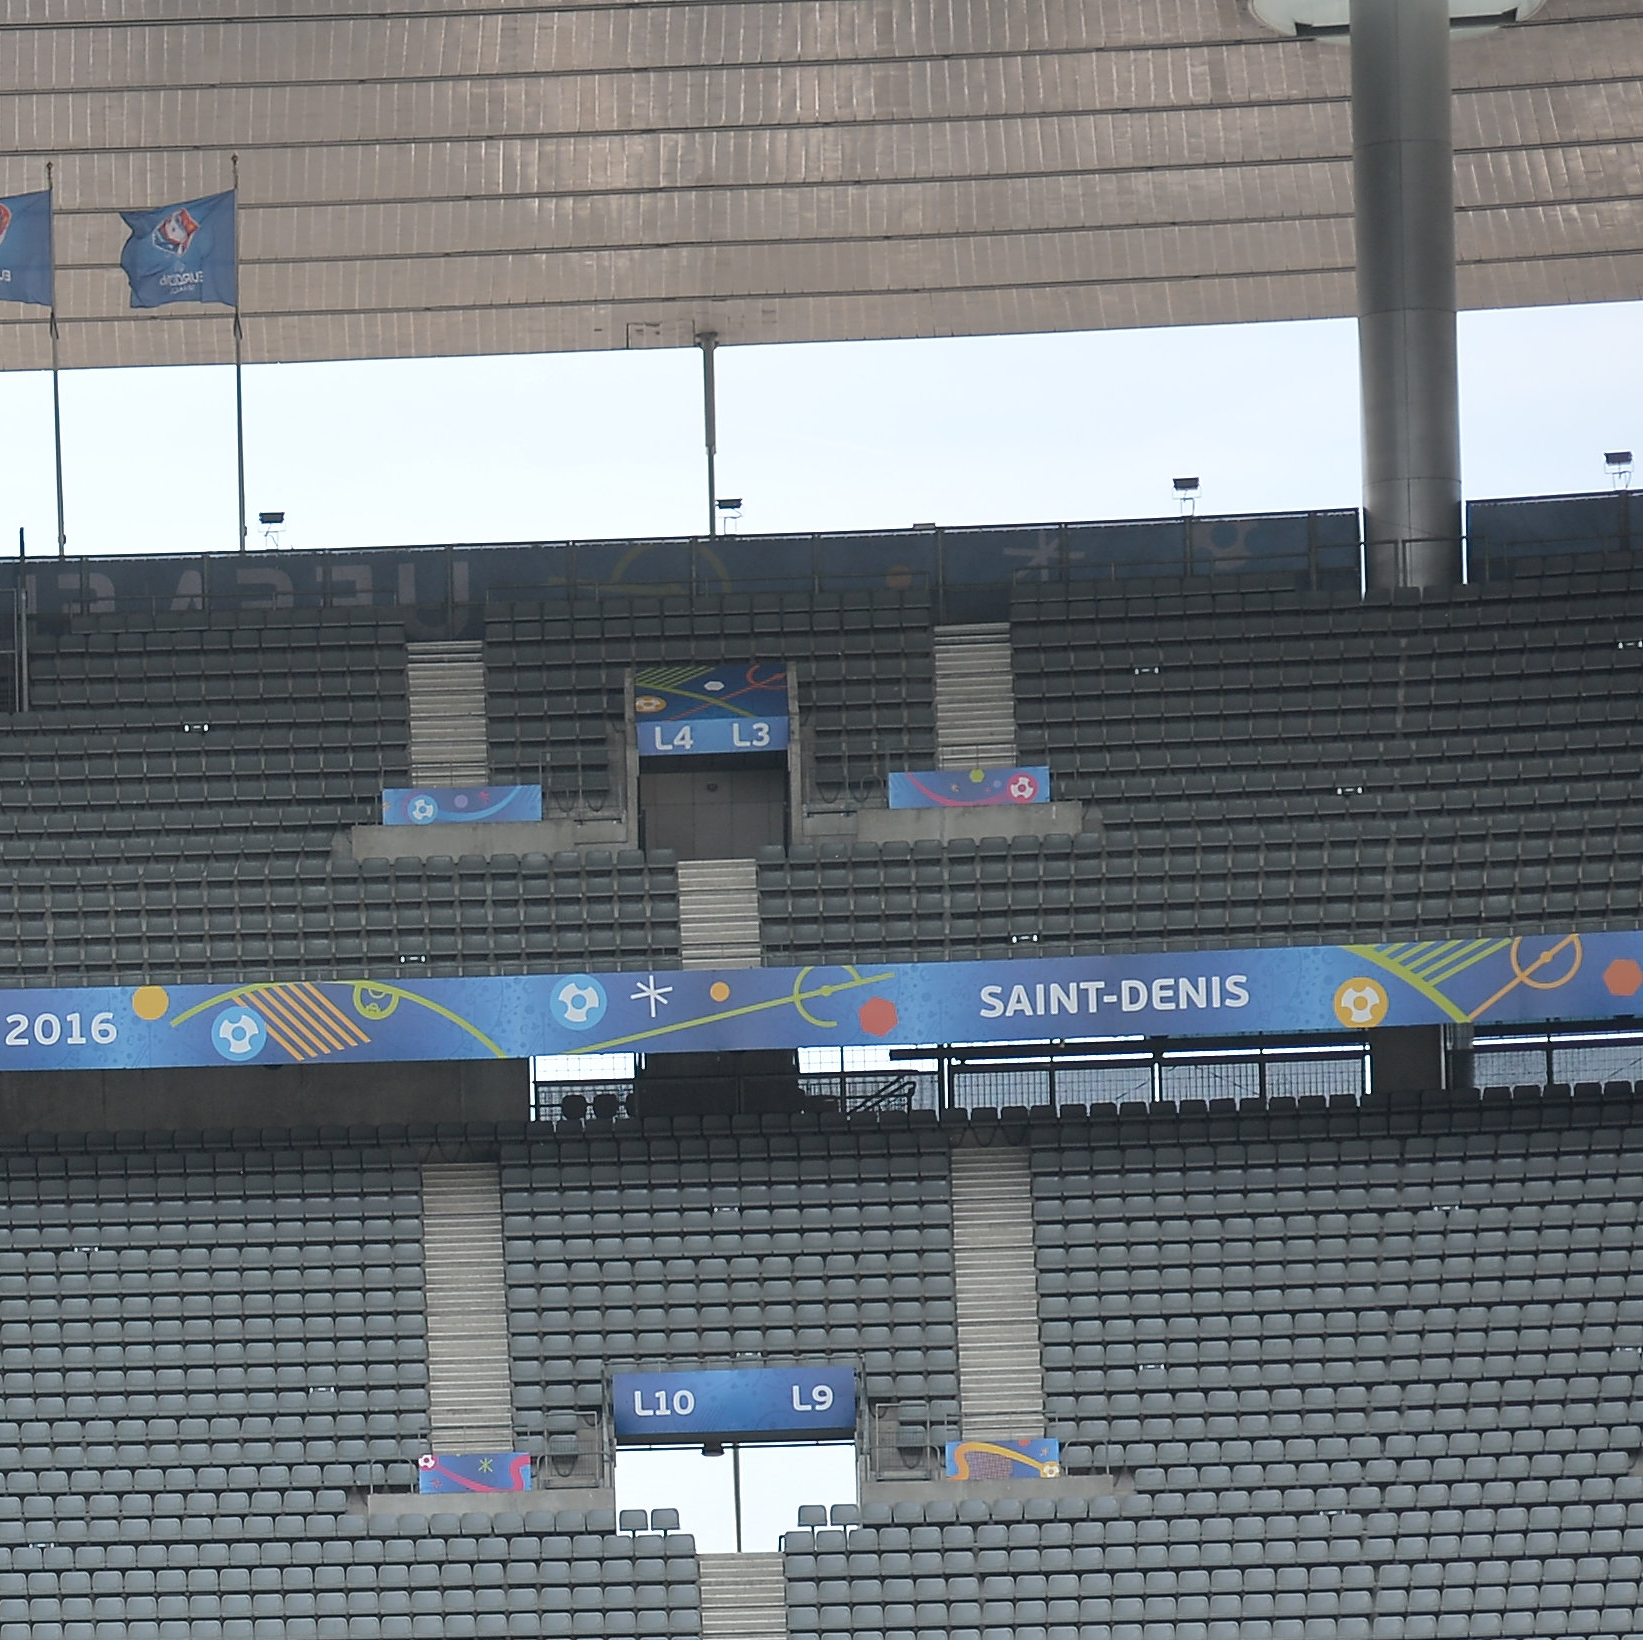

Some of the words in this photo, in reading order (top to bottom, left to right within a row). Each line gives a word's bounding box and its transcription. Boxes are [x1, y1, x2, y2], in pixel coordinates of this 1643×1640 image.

[655, 726, 693, 750] L4
[733, 723, 769, 746] L3
[980, 975, 1249, 1017] SAINT-DENIS
[6, 1012, 116, 1045] 2016
[635, 1390, 694, 1415] L10
[793, 1385, 832, 1410] L9
